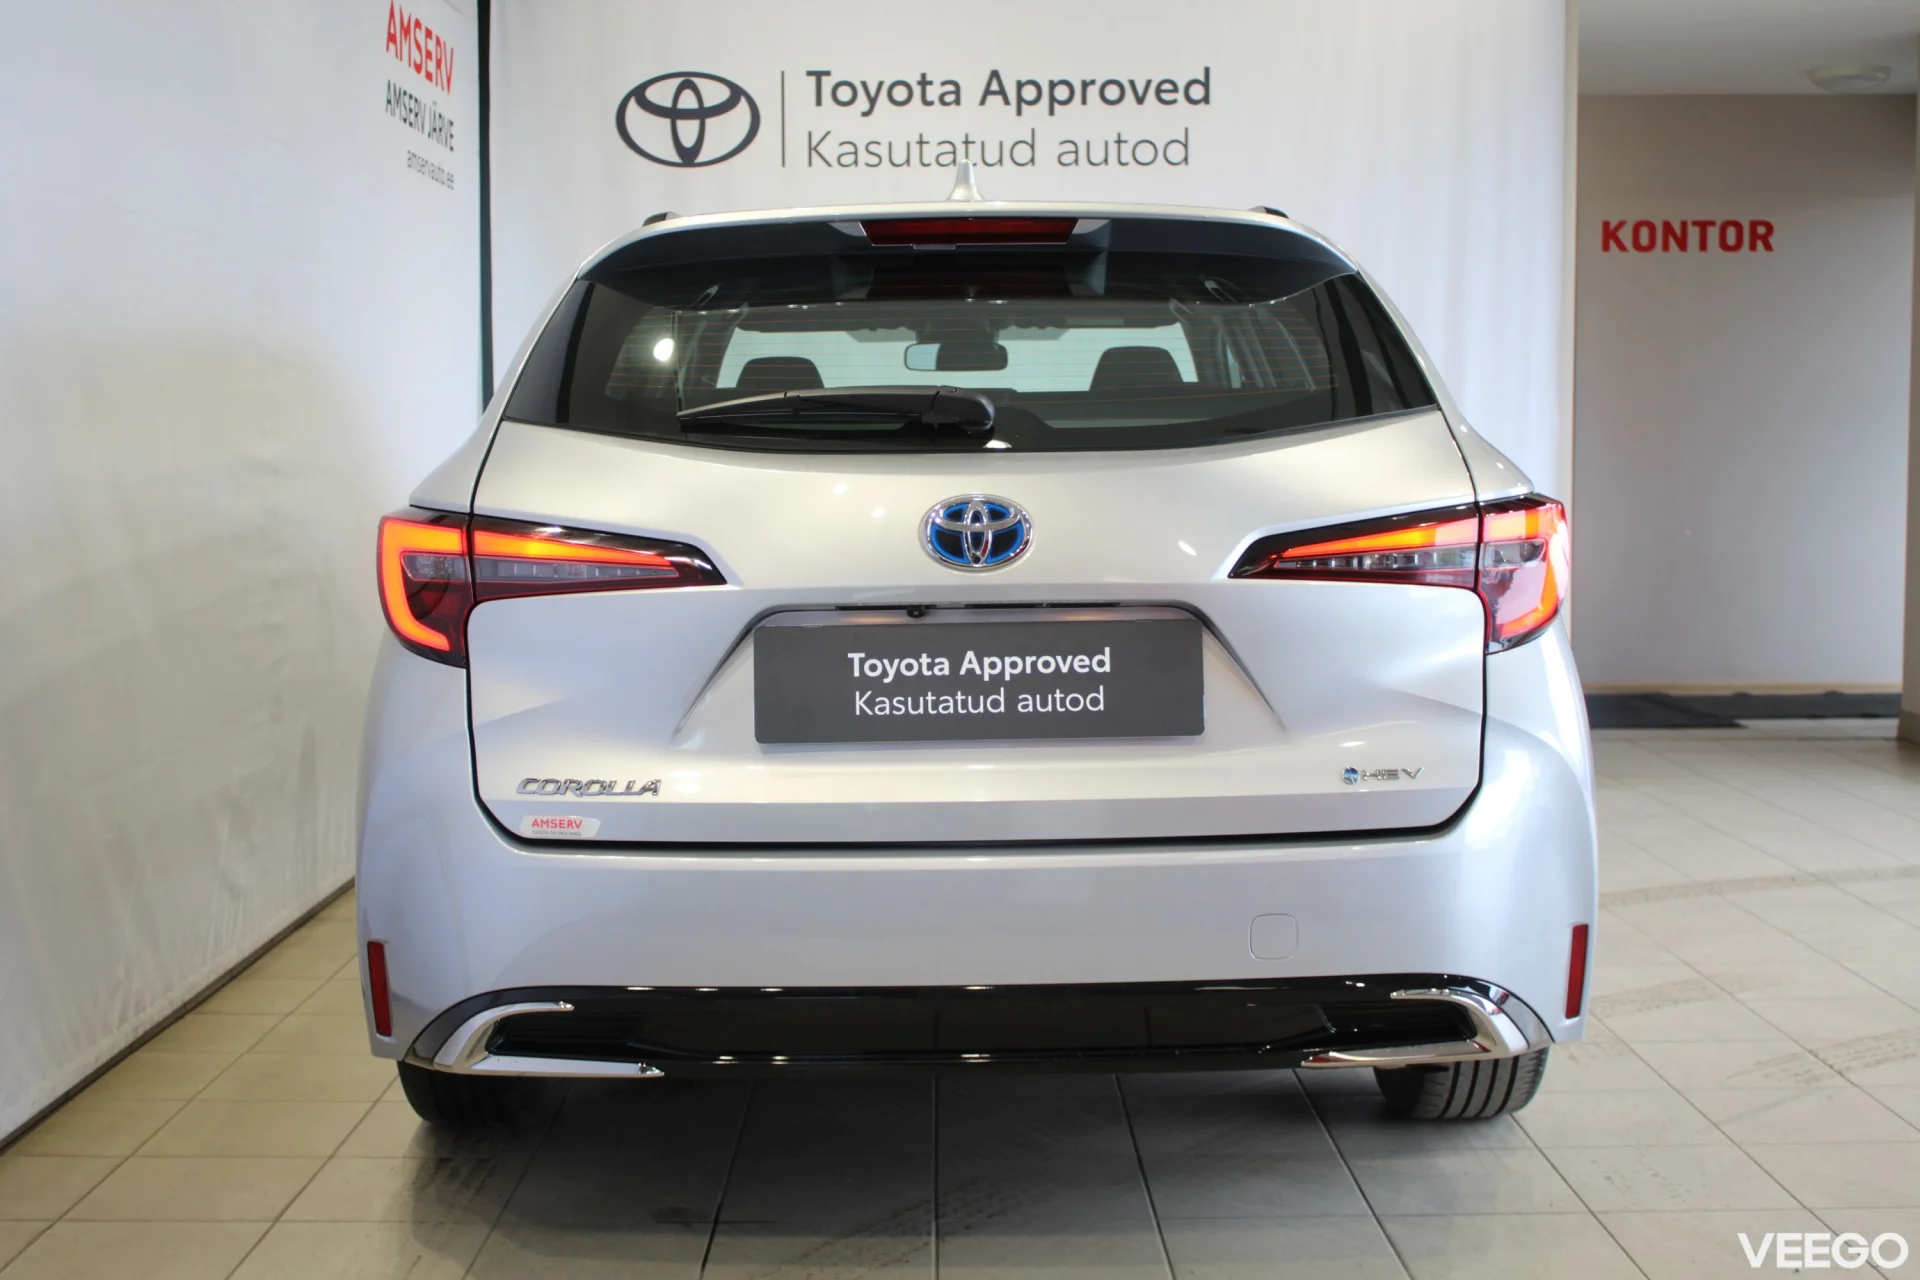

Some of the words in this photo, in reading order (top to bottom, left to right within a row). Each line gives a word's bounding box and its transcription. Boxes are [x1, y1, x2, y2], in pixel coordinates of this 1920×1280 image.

[386, 0, 454, 95] AMSERV
[806, 70, 961, 118] Toyota
[979, 66, 1211, 117] Approved
[385, 80, 427, 135] AMSERV
[427, 100, 454, 152] JÄRVE
[807, 127, 1036, 168] Kasutatud
[1058, 127, 1189, 167] autod
[1601, 219, 1775, 253] KONTOR
[847, 651, 950, 684] Toyota
[959, 646, 1111, 682] Approved
[855, 686, 1005, 716] Kasutatud
[1018, 684, 1105, 713] autod
[516, 777, 662, 798] COROLLA
[1361, 766, 1424, 781] HEV
[531, 817, 583, 830] AMSERV
